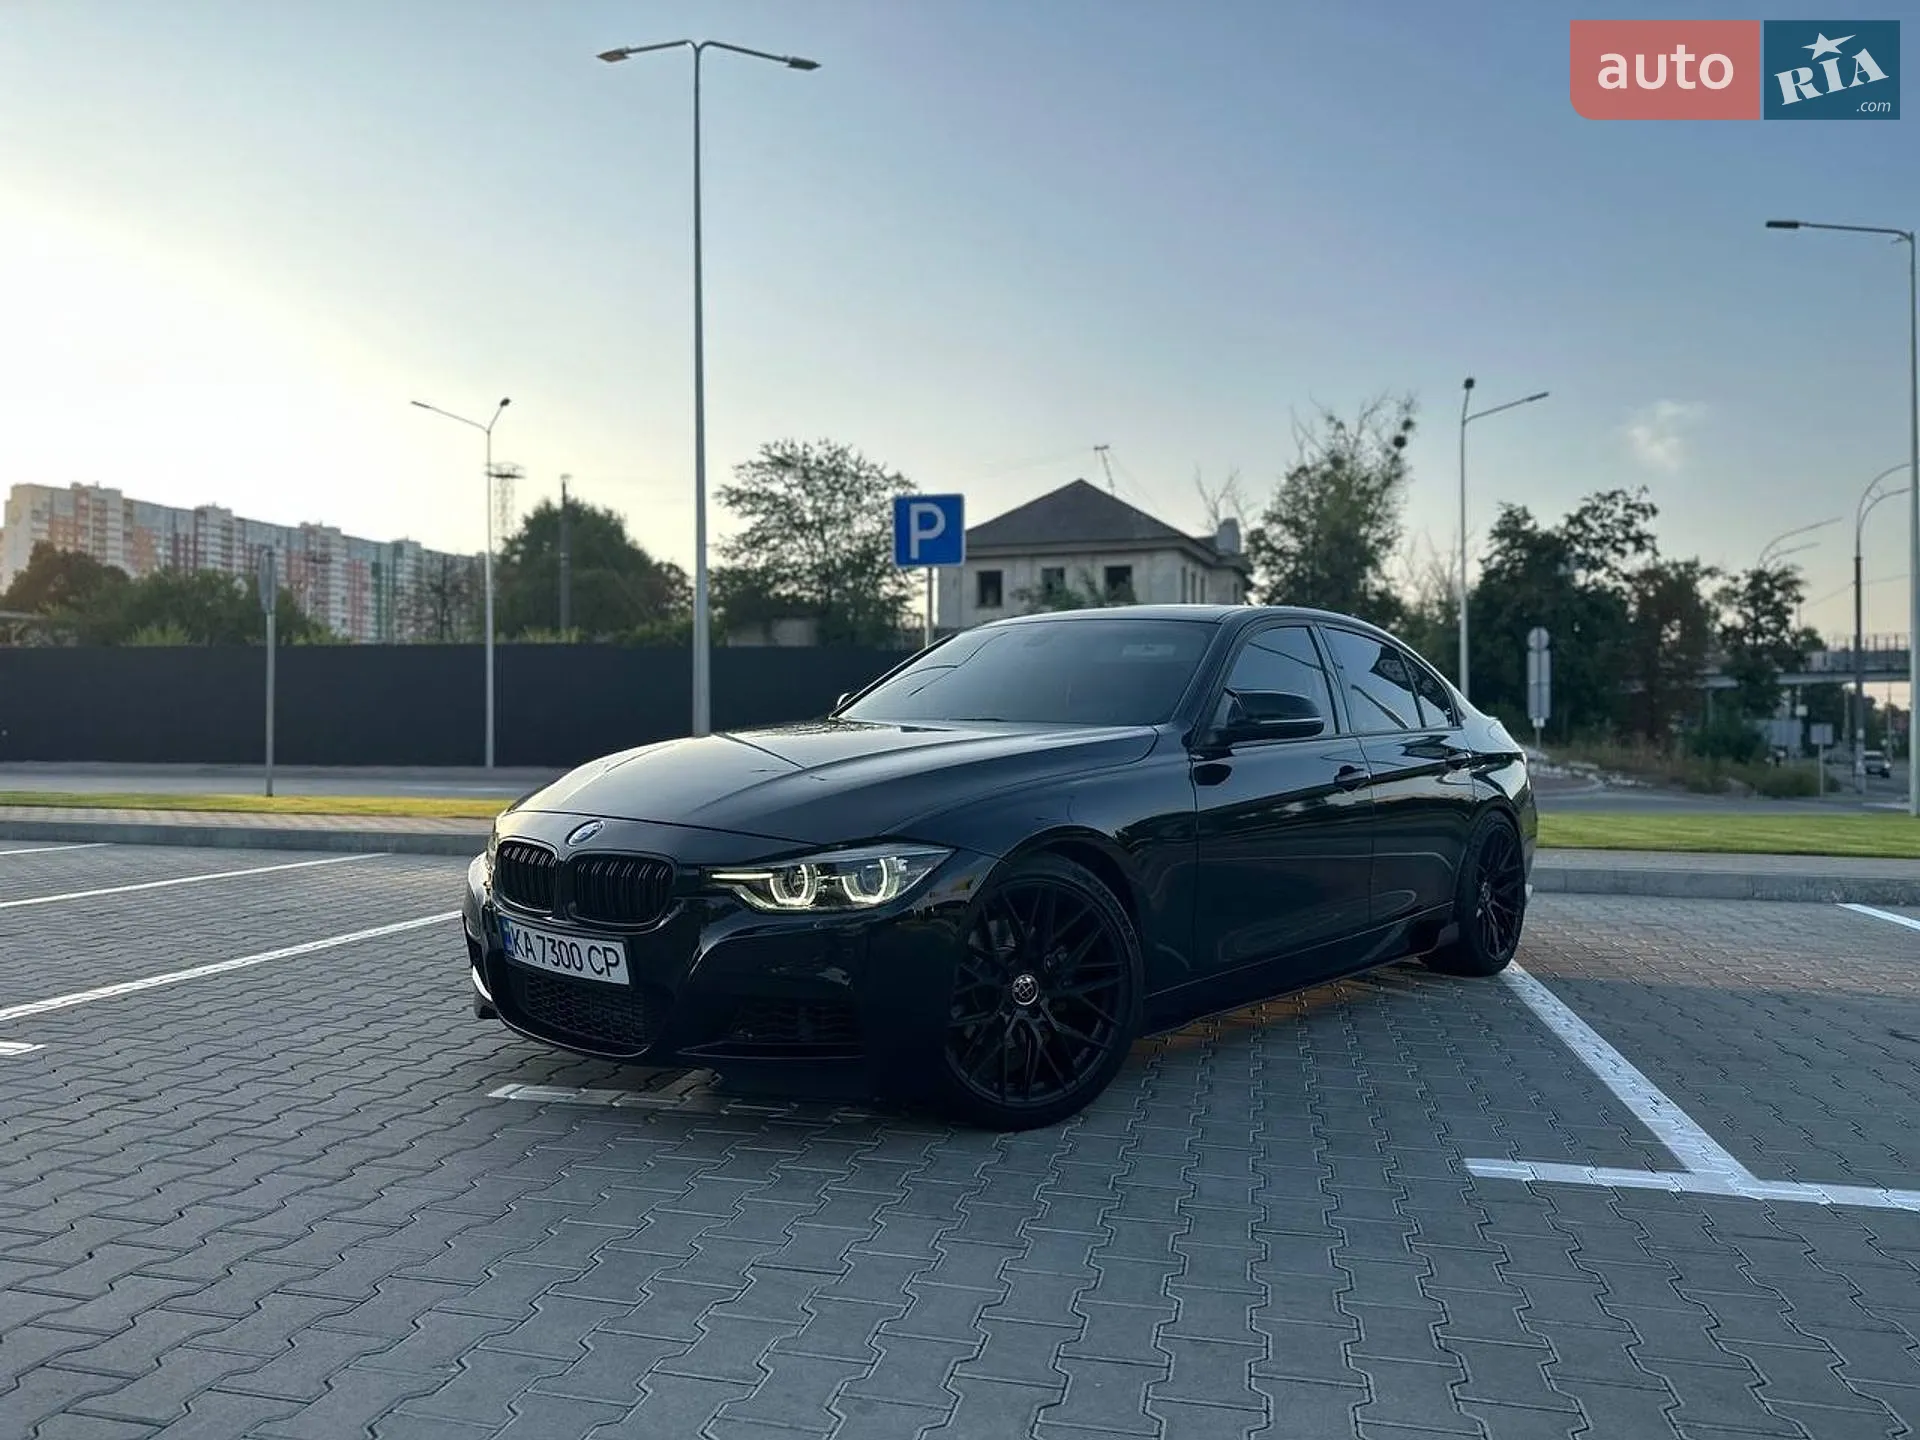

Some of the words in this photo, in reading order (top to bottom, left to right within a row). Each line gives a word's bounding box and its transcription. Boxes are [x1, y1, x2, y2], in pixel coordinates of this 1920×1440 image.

[909, 502, 946, 559] P
[511, 926, 537, 961] KA
[535, 934, 584, 972] 7300
[587, 945, 620, 977] CP
